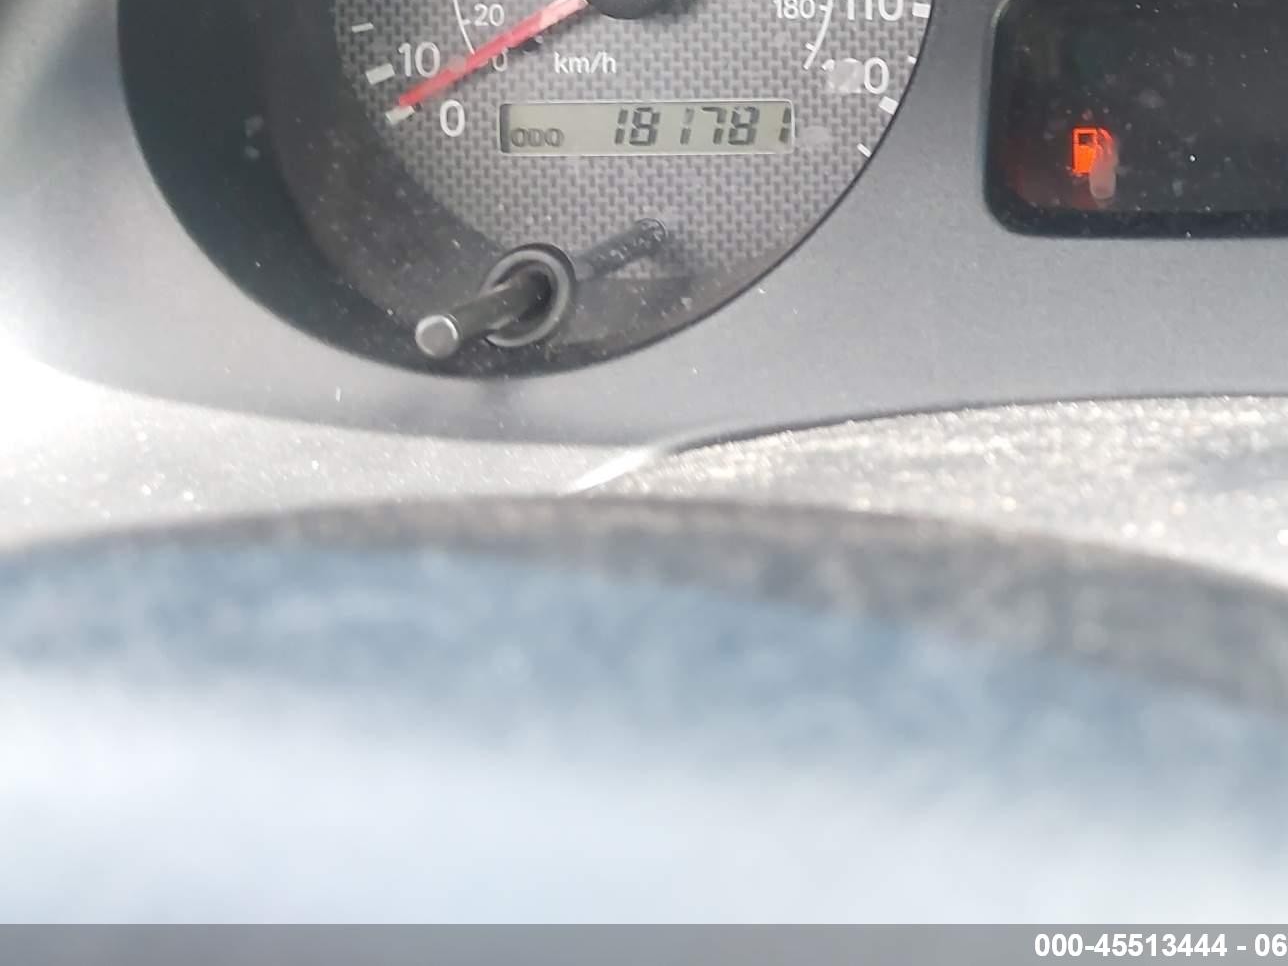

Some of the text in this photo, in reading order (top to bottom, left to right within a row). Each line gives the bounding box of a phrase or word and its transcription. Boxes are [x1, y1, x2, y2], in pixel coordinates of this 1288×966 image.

[474, 4, 505, 27] 20
[398, 41, 441, 77] 10
[553, 50, 617, 74] km/h
[439, 99, 466, 136] 0
